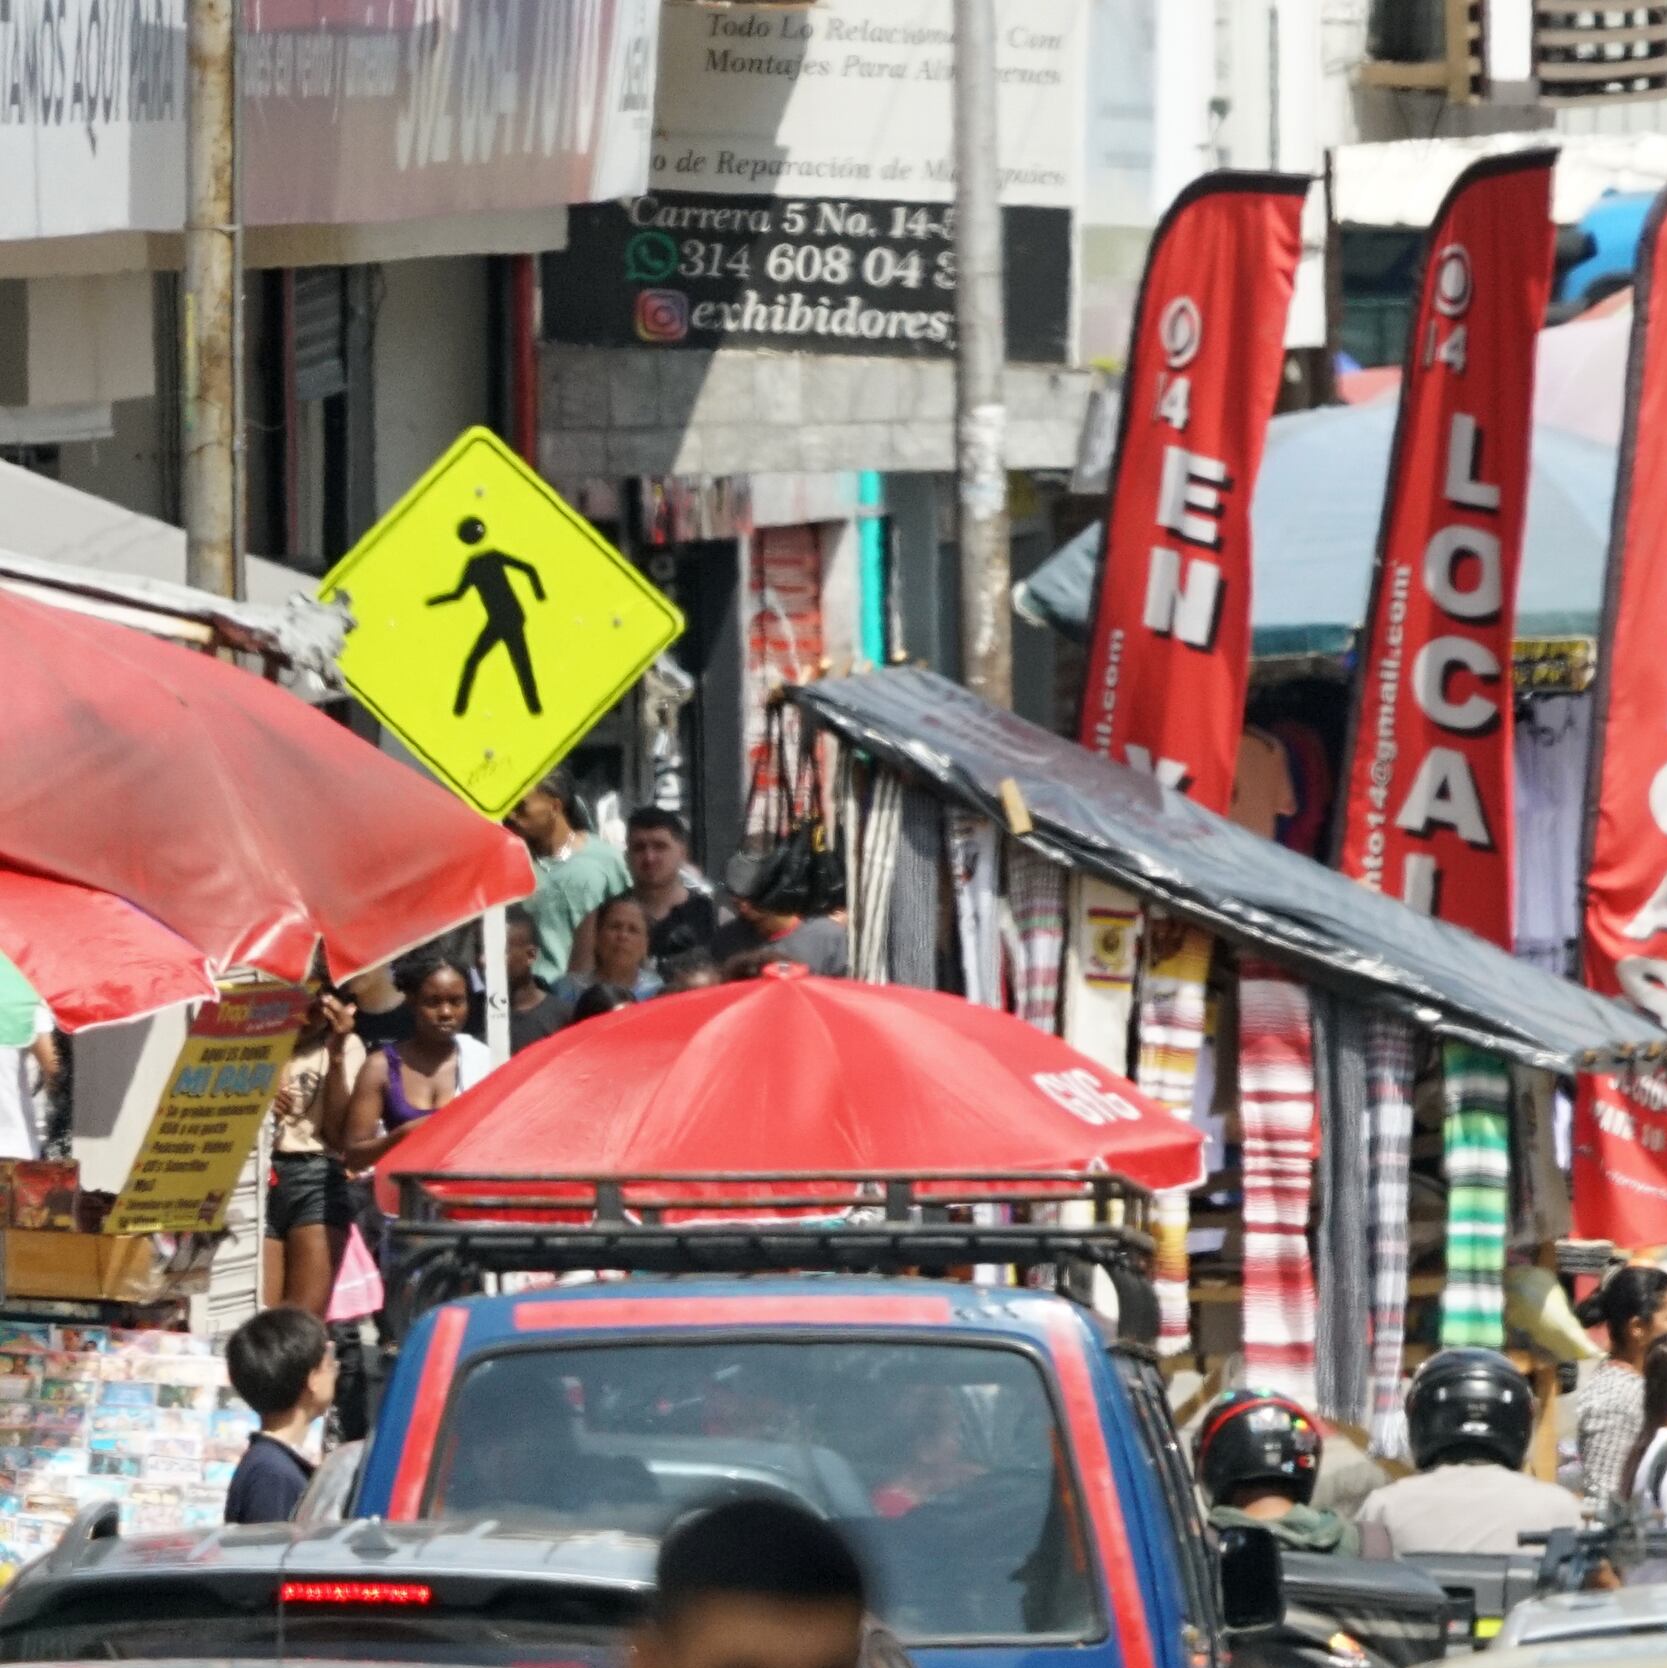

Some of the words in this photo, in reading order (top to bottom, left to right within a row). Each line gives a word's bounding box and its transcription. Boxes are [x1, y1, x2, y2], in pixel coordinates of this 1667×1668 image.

[706, 13, 770, 38] Todo
[780, 15, 813, 41] Lo
[704, 48, 830, 81] Montajes
[676, 152, 707, 175] de
[629, 197, 771, 233] Carrera
[781, 202, 808, 234] 5
[815, 202, 878, 237] No.
[679, 240, 752, 279] 314
[766, 243, 852, 284] 608
[862, 245, 925, 289] 04
[691, 290, 956, 343] exhibidores
